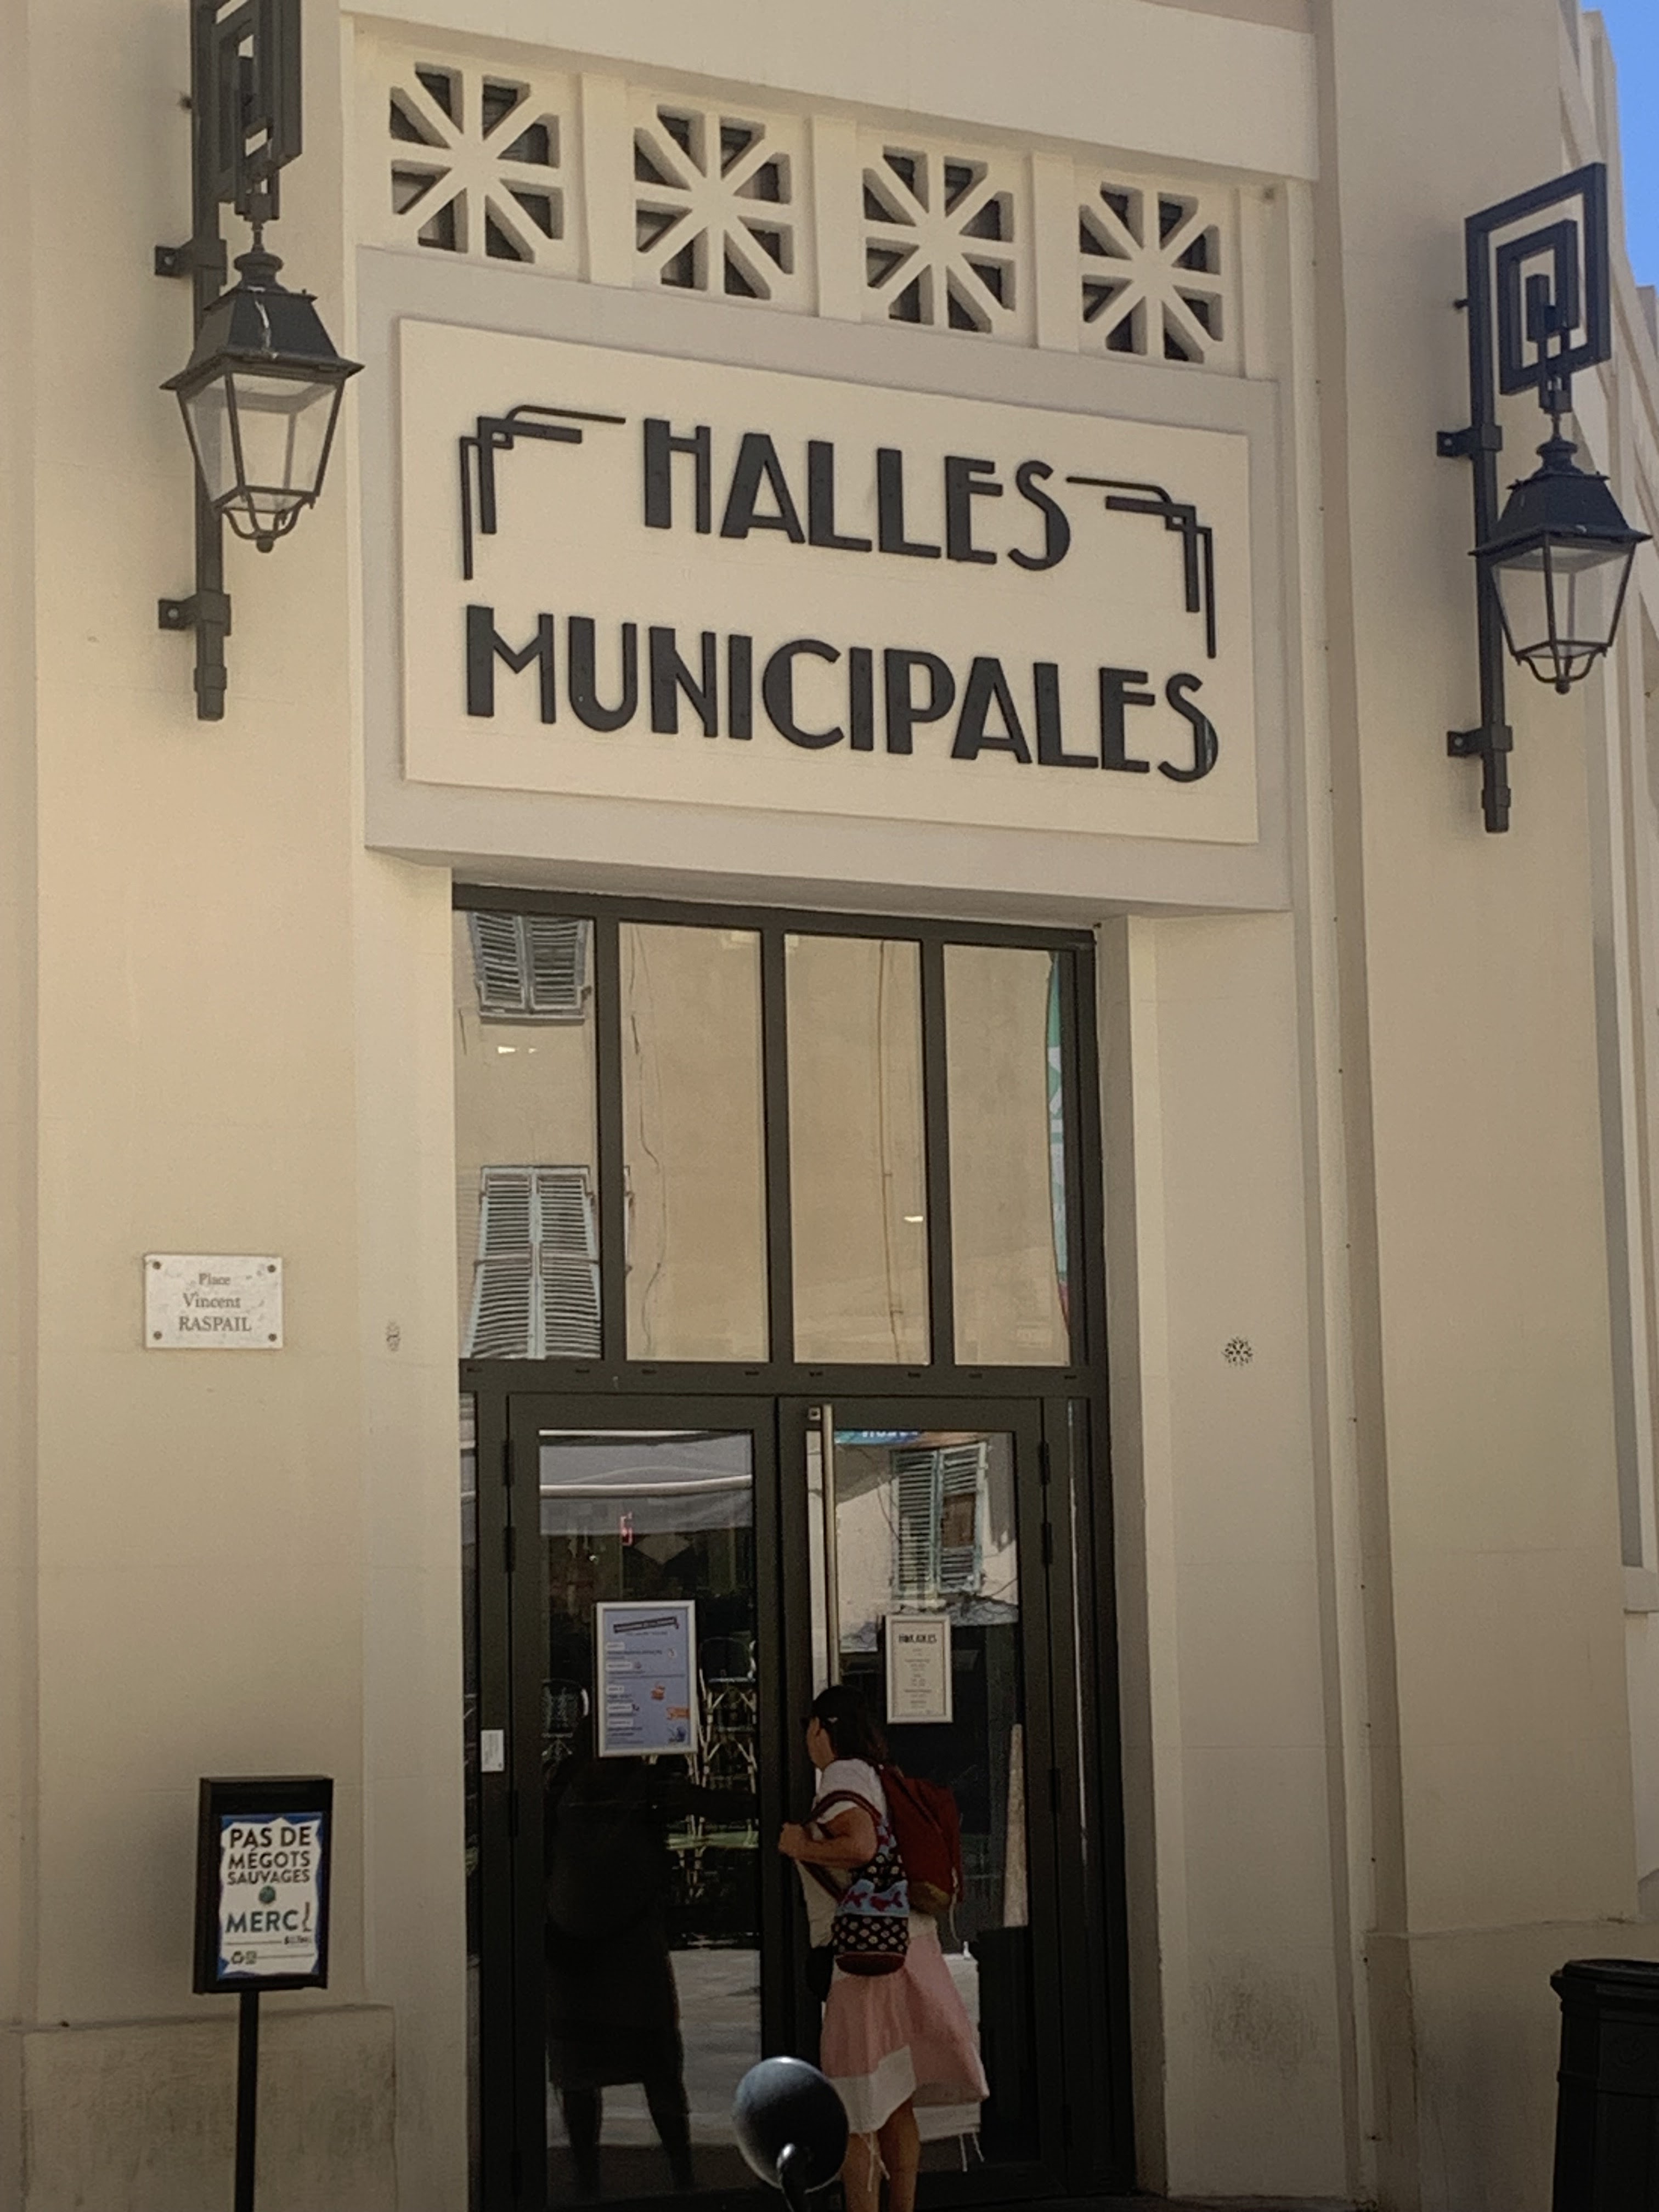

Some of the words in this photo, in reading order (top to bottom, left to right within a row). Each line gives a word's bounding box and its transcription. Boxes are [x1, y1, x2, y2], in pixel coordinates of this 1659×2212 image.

[644, 417, 1071, 571] HALLES
[466, 605, 1218, 783] MUNICIPALES
[199, 1273, 231, 1285] Place
[183, 1291, 241, 1308] Vincent
[179, 1316, 252, 1332] RASPAIL
[230, 1827, 272, 1848] PAS
[280, 1826, 312, 1847] DE
[229, 1848, 311, 1870] MÉGOTS
[227, 1869, 311, 1886] SAUVAGES
